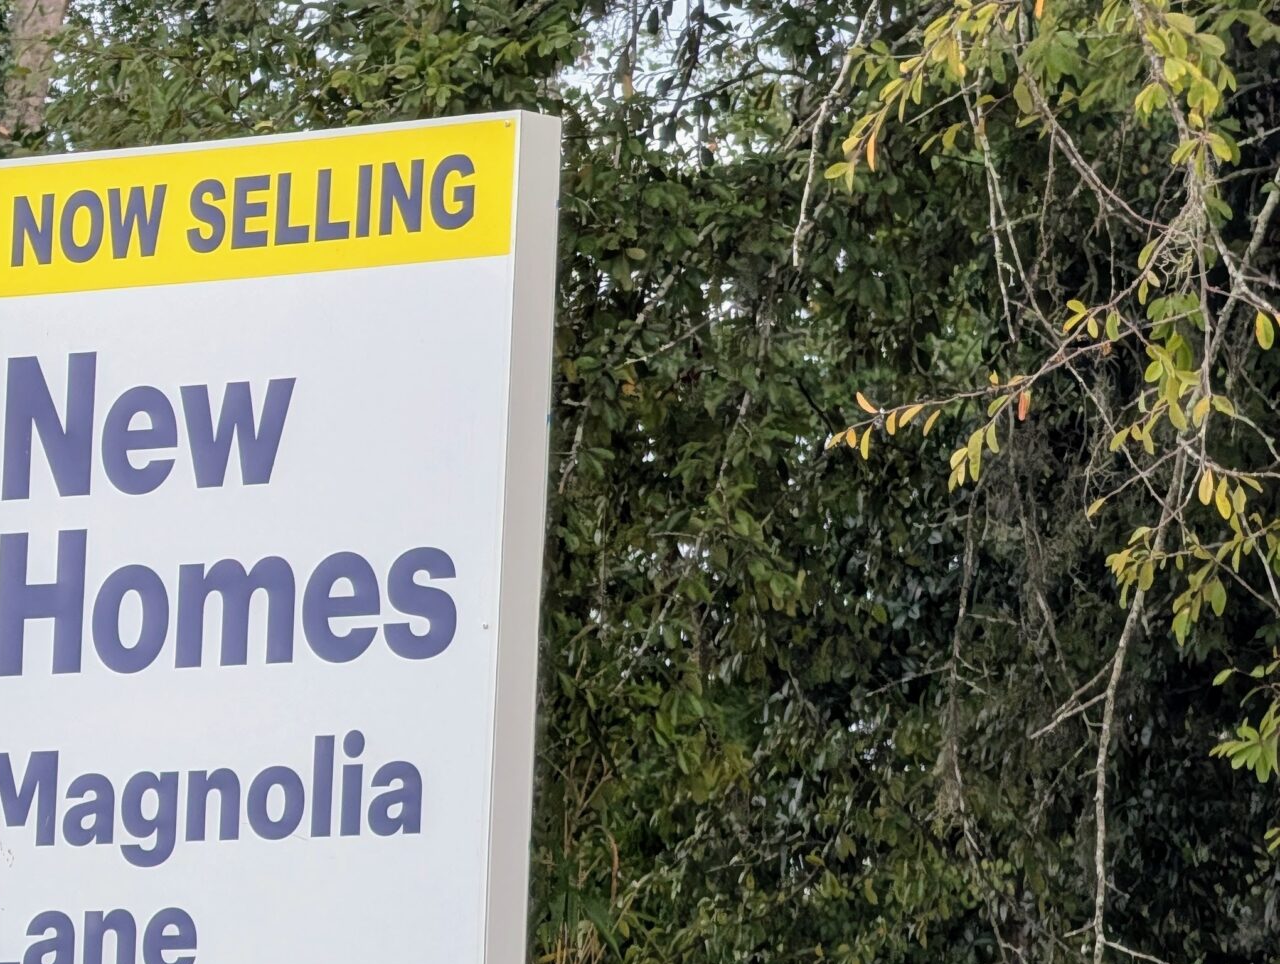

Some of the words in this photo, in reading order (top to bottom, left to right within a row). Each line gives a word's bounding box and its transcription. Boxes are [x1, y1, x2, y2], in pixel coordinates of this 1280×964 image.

[10, 183, 167, 267] NOW
[187, 153, 476, 254] SELLING
[1, 351, 297, 501] New
